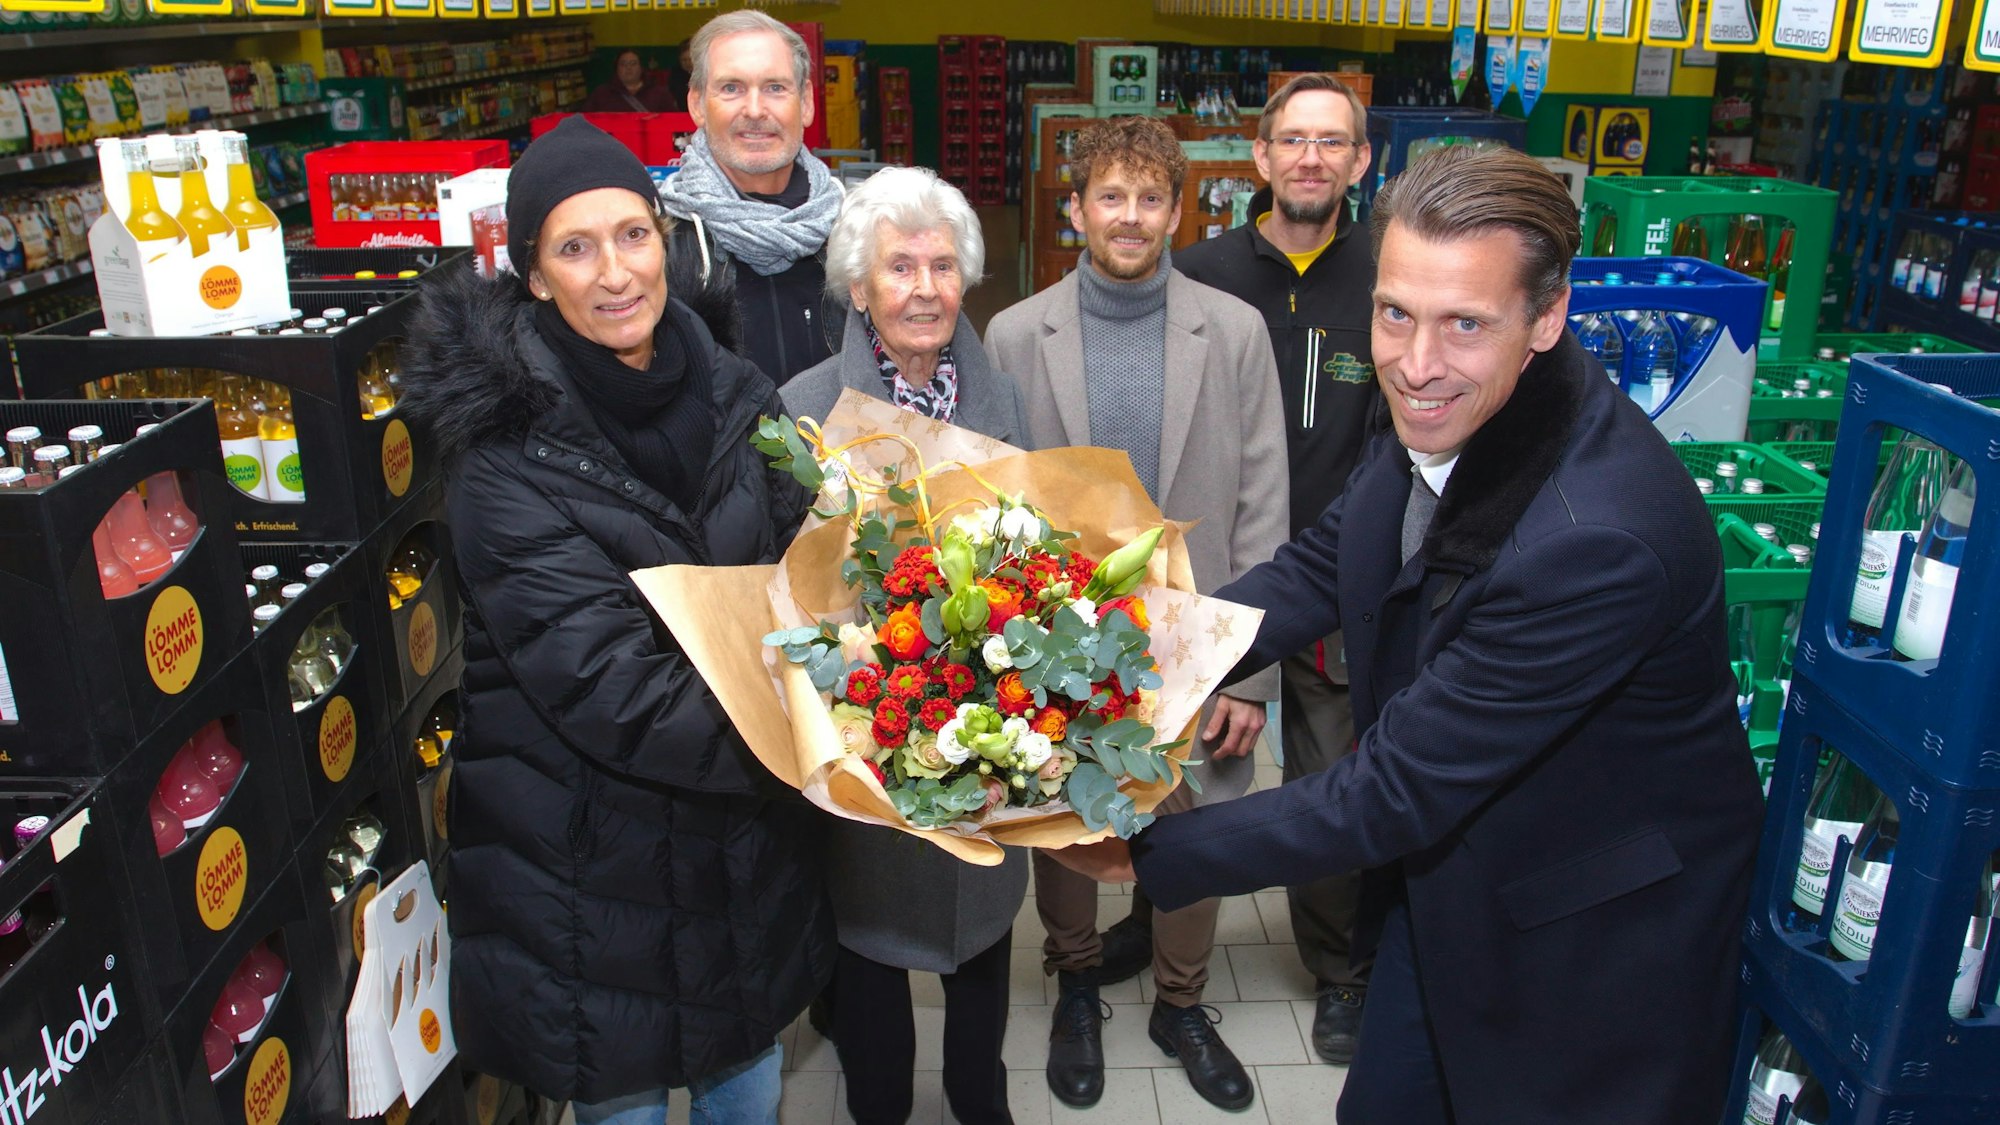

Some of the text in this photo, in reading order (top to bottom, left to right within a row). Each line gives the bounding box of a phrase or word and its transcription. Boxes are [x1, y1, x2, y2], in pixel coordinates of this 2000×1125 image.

[1777, 27, 1827, 47] MEHRWEG
[1864, 25, 1929, 46] MEHRWEG
[1644, 217, 1667, 256] FEL
[201, 277, 239, 291] LÖMME
[384, 436, 410, 465] LÖMME
[226, 464, 257, 476] ÖMME
[252, 521, 299, 531] Erfrischend.
[149, 606, 197, 658] LÖMME
[321, 710, 353, 754] LÖMME
[200, 841, 243, 899] LÖMME
[1834, 912, 1874, 944] MEDIU
[247, 1050, 286, 1112] LÖMME
